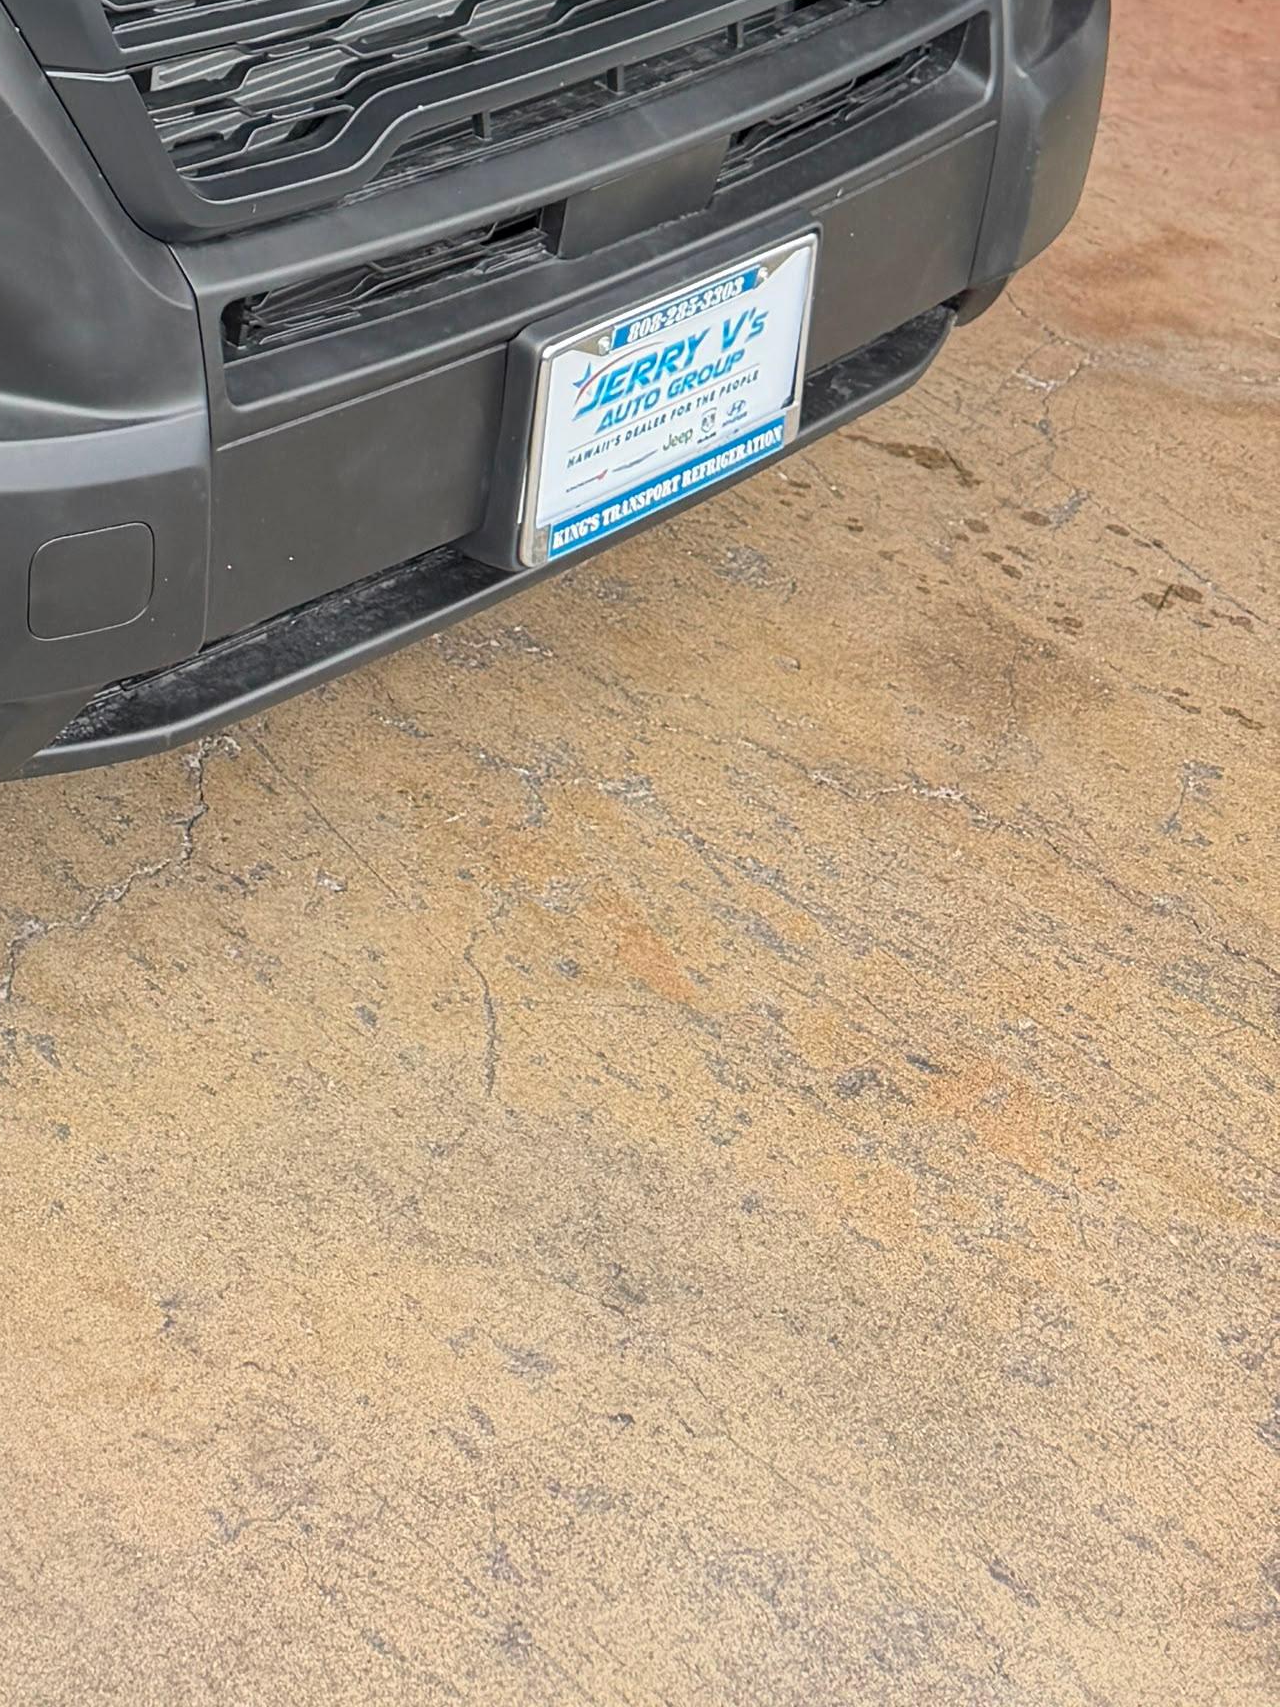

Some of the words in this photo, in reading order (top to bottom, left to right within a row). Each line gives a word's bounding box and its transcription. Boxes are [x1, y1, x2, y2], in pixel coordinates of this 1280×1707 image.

[627, 276, 745, 344] 808-285-3303
[566, 432, 622, 469] HAWAII'S
[624, 413, 666, 442] DEALER
[670, 401, 691, 421] FOR
[695, 388, 716, 408] THE
[719, 369, 760, 399] PEOPLE
[572, 326, 711, 421] JERRY
[595, 387, 661, 435] AUTO
[667, 348, 745, 401] GROUP
[662, 427, 694, 453] Jeep
[552, 515, 600, 550] KING'S
[601, 473, 682, 529] TRANSPORT
[681, 424, 784, 488] REFRIGERATION
